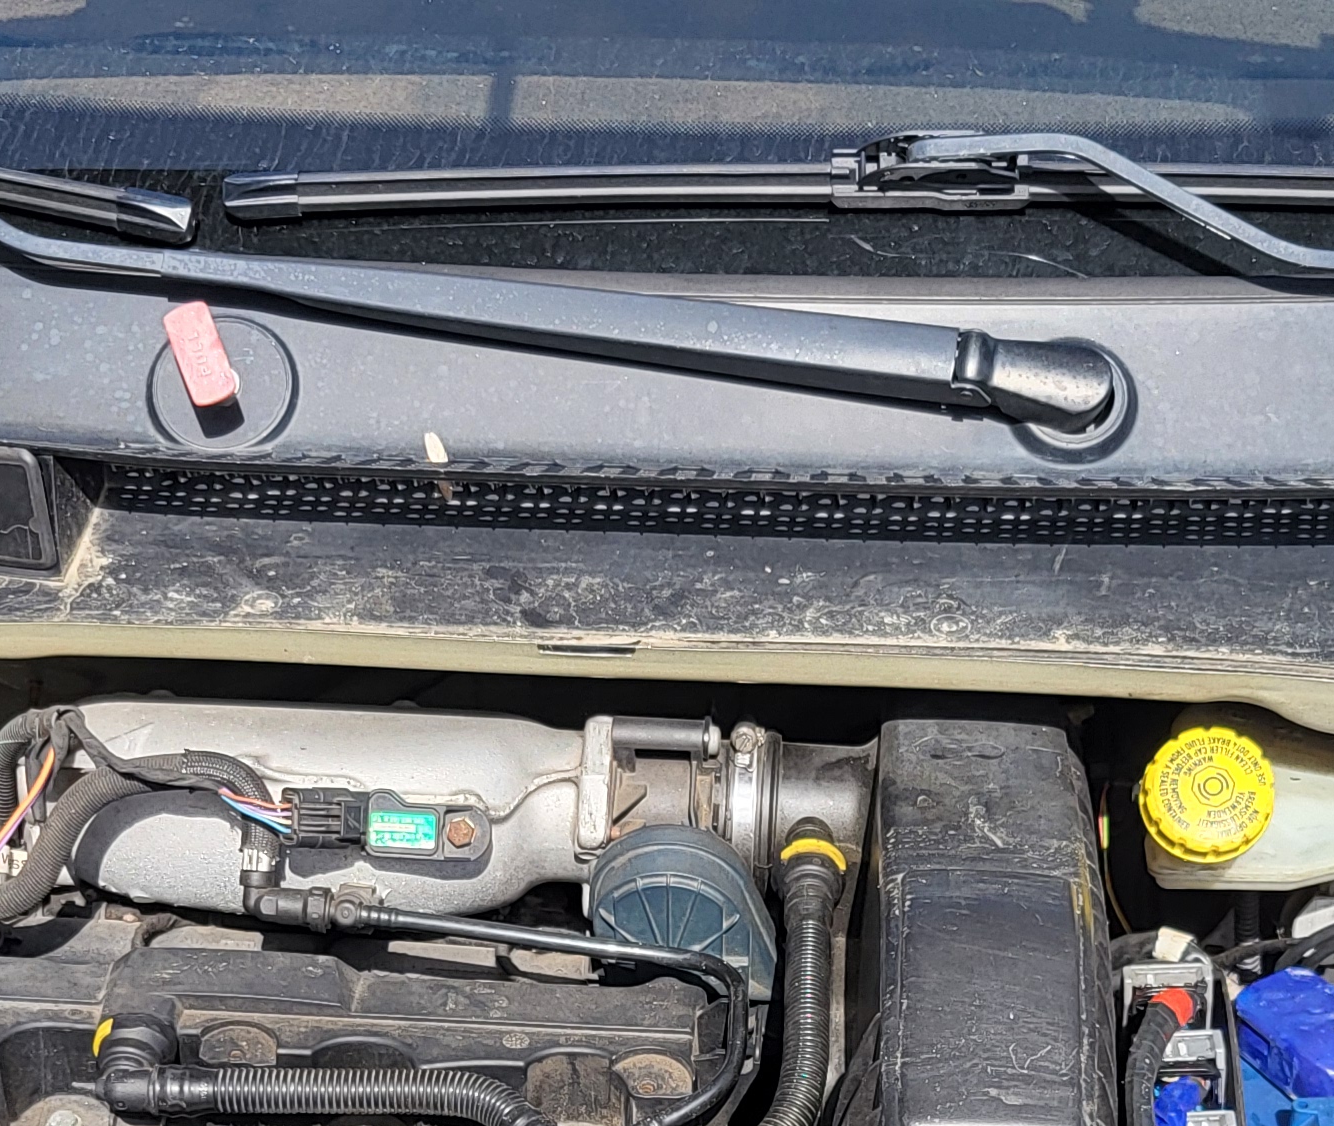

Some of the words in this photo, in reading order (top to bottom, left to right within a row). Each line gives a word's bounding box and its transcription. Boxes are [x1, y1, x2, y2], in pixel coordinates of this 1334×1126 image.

[188, 329, 213, 376] PULL
[1184, 738, 1205, 751] FLUID
[1207, 736, 1232, 747] BRAKE
[1168, 747, 1186, 764] FROM
[1193, 747, 1208, 758] CAP
[1209, 745, 1235, 760] FILLER
[1172, 753, 1194, 777] BEFORE
[1183, 755, 1214, 778] WARNING
[1234, 756, 1254, 776] CLEAN
